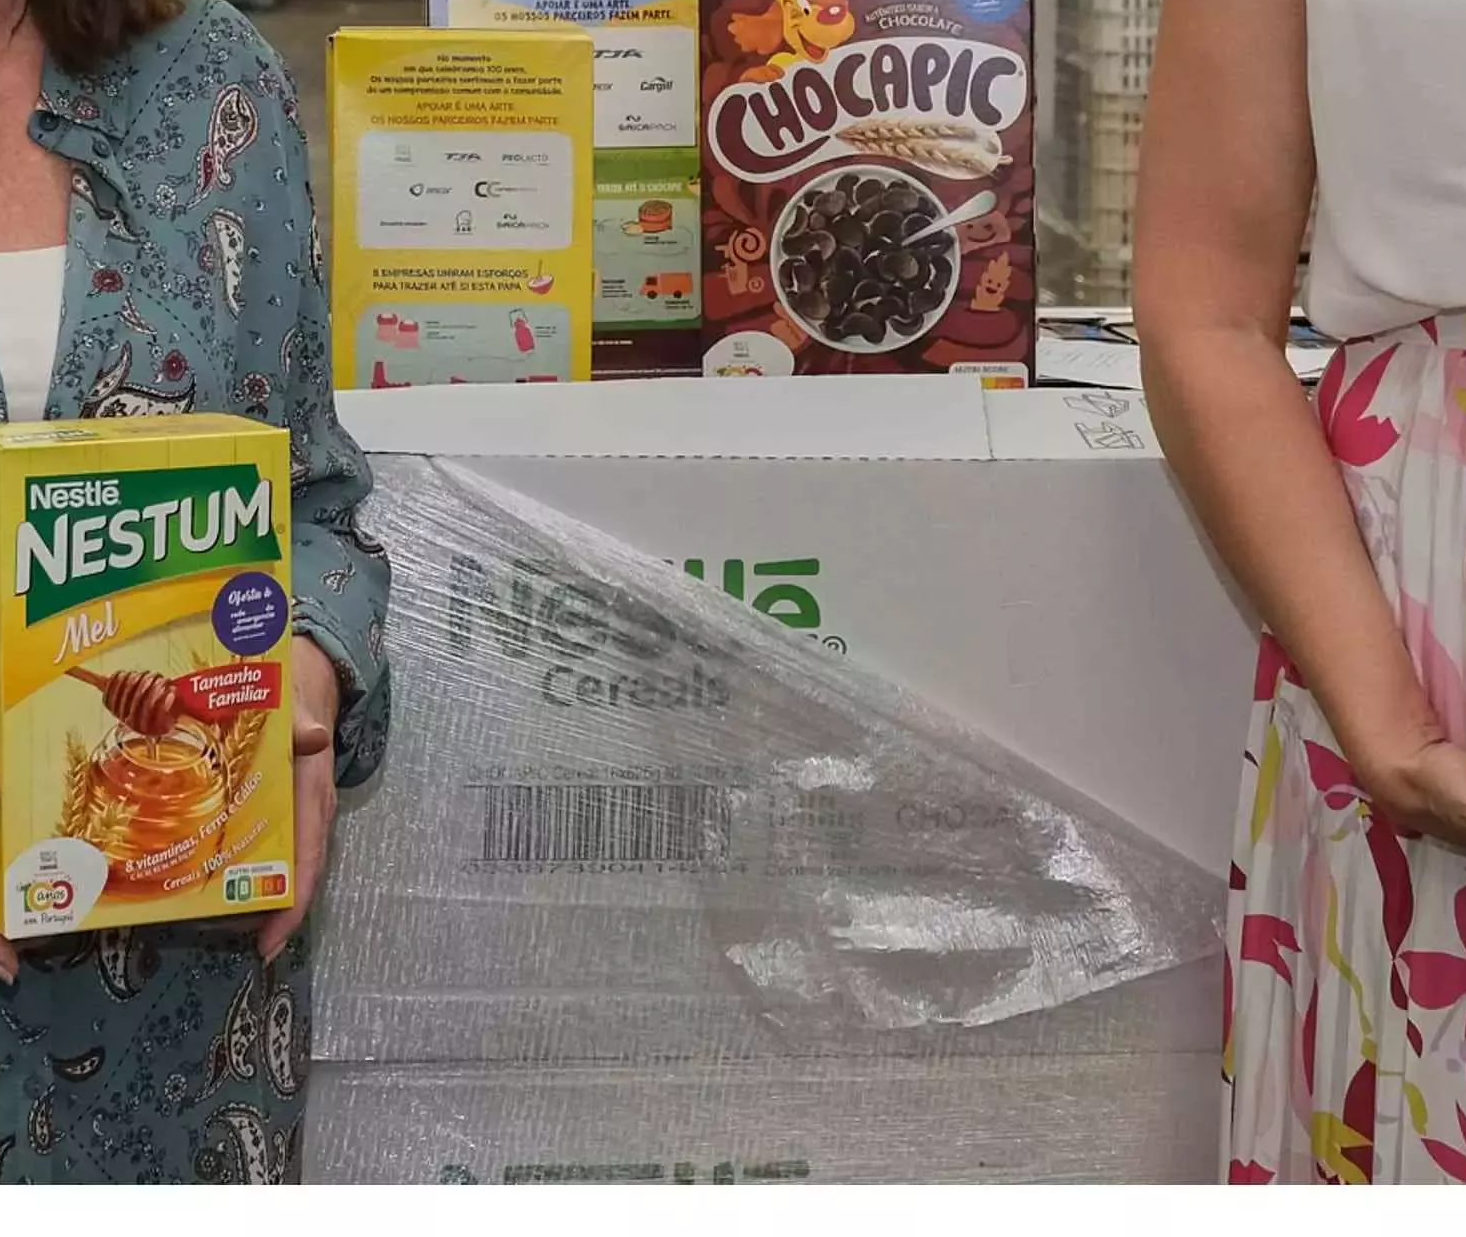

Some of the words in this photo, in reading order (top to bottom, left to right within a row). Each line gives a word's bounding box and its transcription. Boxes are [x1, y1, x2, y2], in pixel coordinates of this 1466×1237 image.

[511, 11, 550, 21] NOSSOS
[553, 10, 606, 20] PARCEIROS
[609, 10, 640, 20] FAZEM
[535, 0, 571, 10] APOIAR
[582, 0, 604, 10] UMA
[878, 14, 963, 36] CHOCOLATE
[639, 77, 673, 92] Cargill
[416, 103, 453, 112] APOIAR
[464, 103, 487, 112] UMA
[715, 43, 1017, 175] CHOCAPIC
[387, 116, 430, 126] NOSSOS
[433, 116, 490, 126] PARCEIROS
[372, 282, 397, 291] PARA
[400, 282, 437, 291] TRAZER
[440, 280, 457, 291] ATÉ
[471, 282, 495, 291] ESTA
[498, 282, 522, 291] PAPA
[381, 269, 433, 278] EMPRESAS
[437, 269, 474, 278] UNIRAM
[477, 268, 529, 279] ESFORÇOS
[30, 479, 120, 510] Nestlé
[14, 479, 272, 595] NESTUM
[53, 601, 119, 665] Mel
[190, 666, 261, 693] Tamanho
[541, 664, 730, 708] Cereals
[208, 684, 272, 710] Familiar
[125, 860, 135, 874] 8
[198, 811, 230, 841] Ferro
[233, 771, 263, 806] Cálcio
[163, 868, 202, 892] Cereais
[202, 849, 232, 874] 100%
